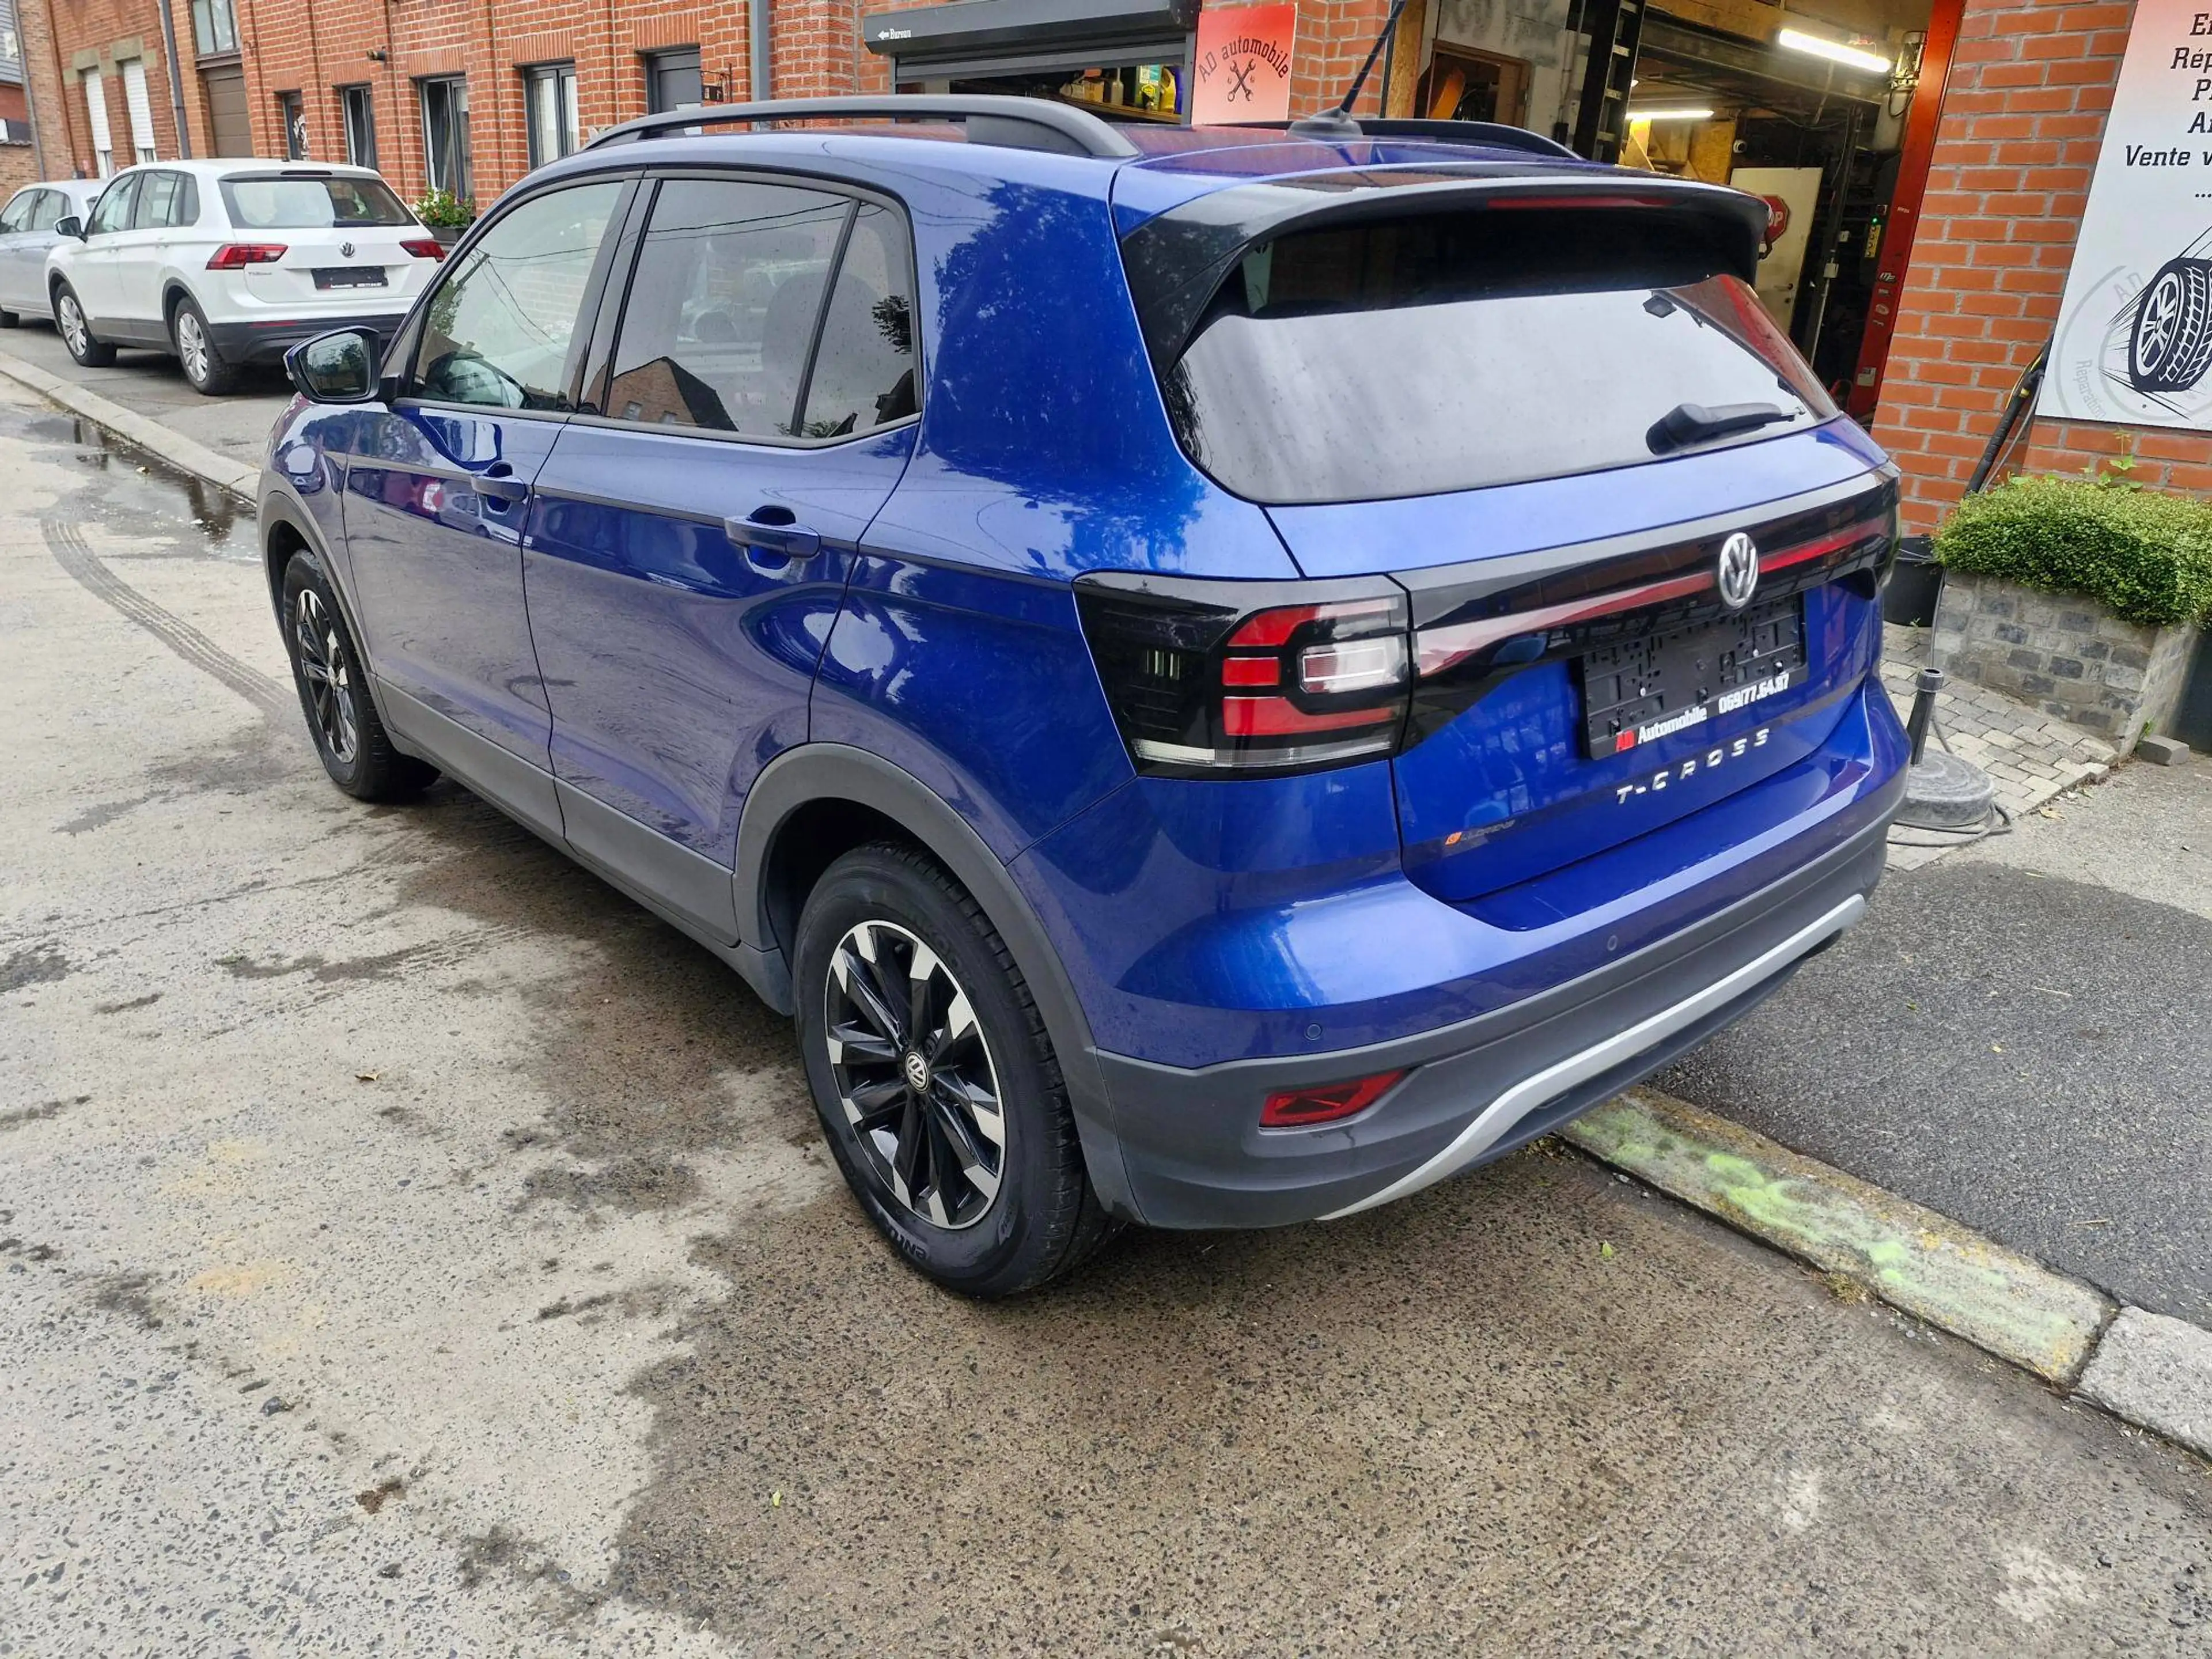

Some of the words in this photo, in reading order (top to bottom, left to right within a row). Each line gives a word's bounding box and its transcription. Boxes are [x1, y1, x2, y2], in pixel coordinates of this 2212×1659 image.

[889, 28, 911, 39] Bureau
[1198, 51, 1217, 82] AD
[1221, 35, 1289, 78] automobile
[2126, 145, 2191, 166] Vente
[1638, 706, 1707, 744] Automobile
[1616, 728, 1770, 805] T-CROSS
